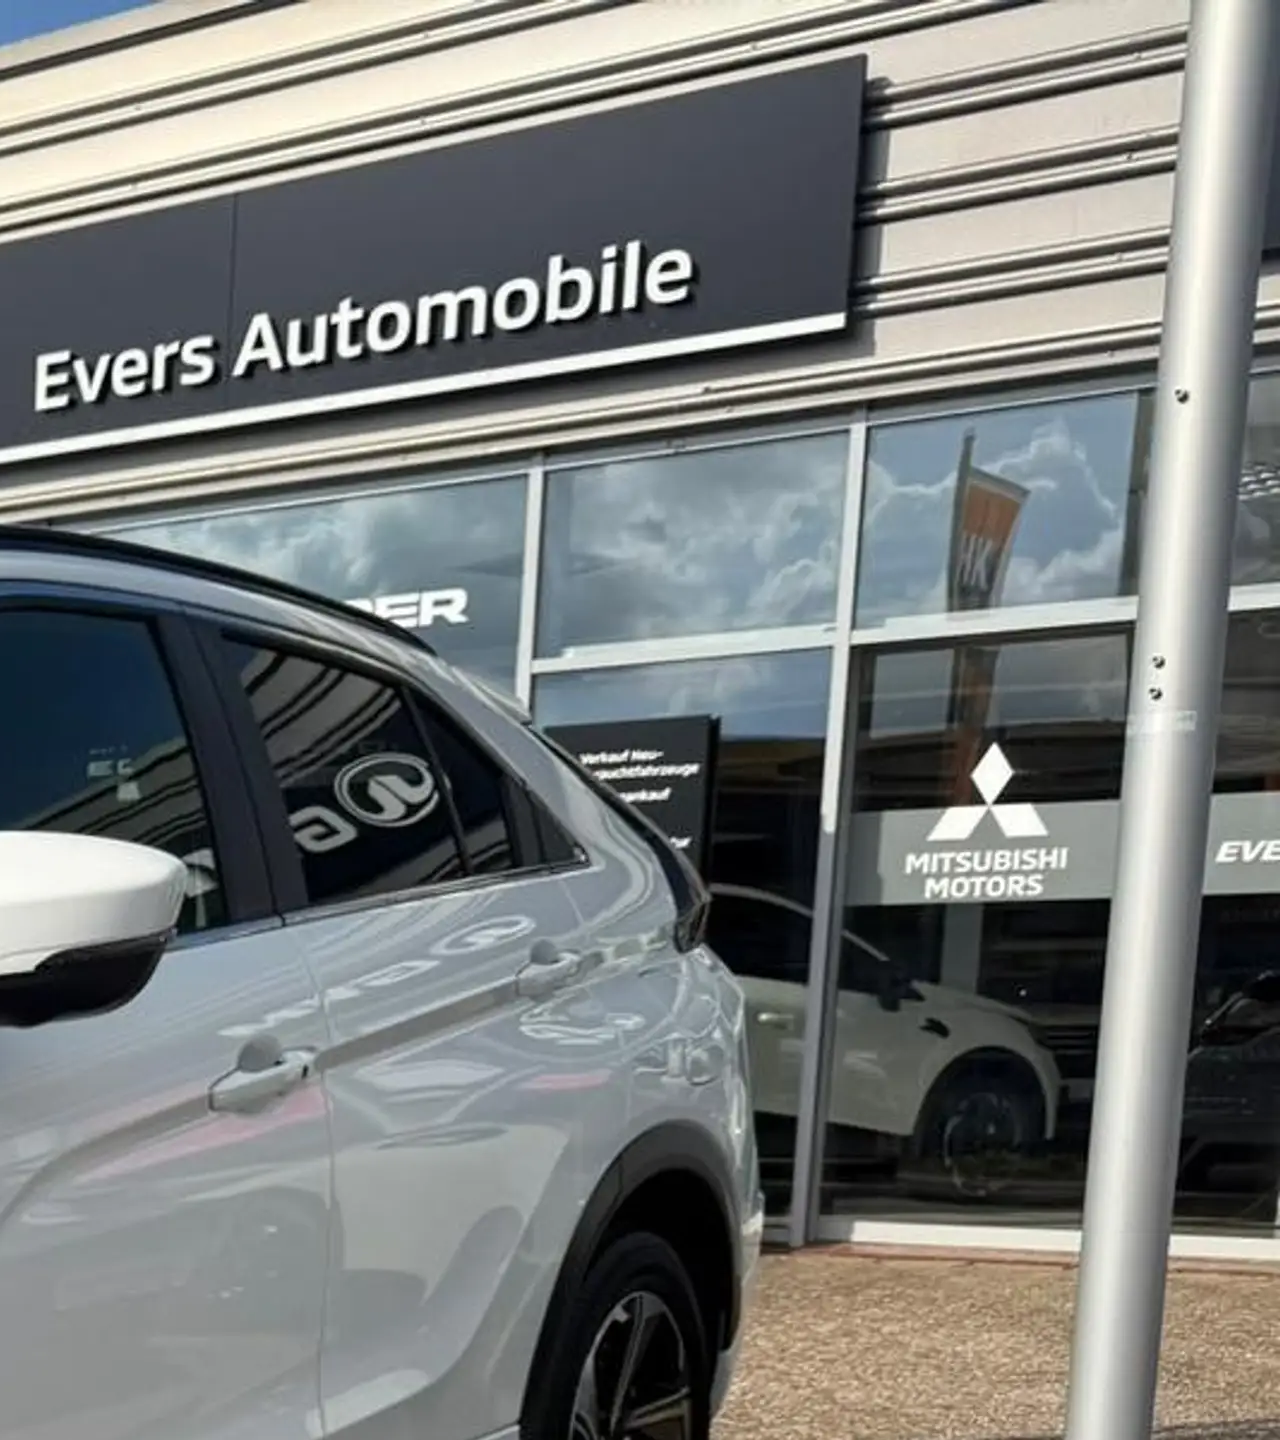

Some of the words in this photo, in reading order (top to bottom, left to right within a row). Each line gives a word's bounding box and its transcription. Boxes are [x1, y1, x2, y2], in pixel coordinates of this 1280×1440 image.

[33, 332, 215, 411] Evers
[233, 239, 693, 377] Automobile
[578, 749, 630, 765] Verkauf
[904, 846, 1070, 875] MITSUBISHI
[924, 873, 1044, 900] MOTORS
